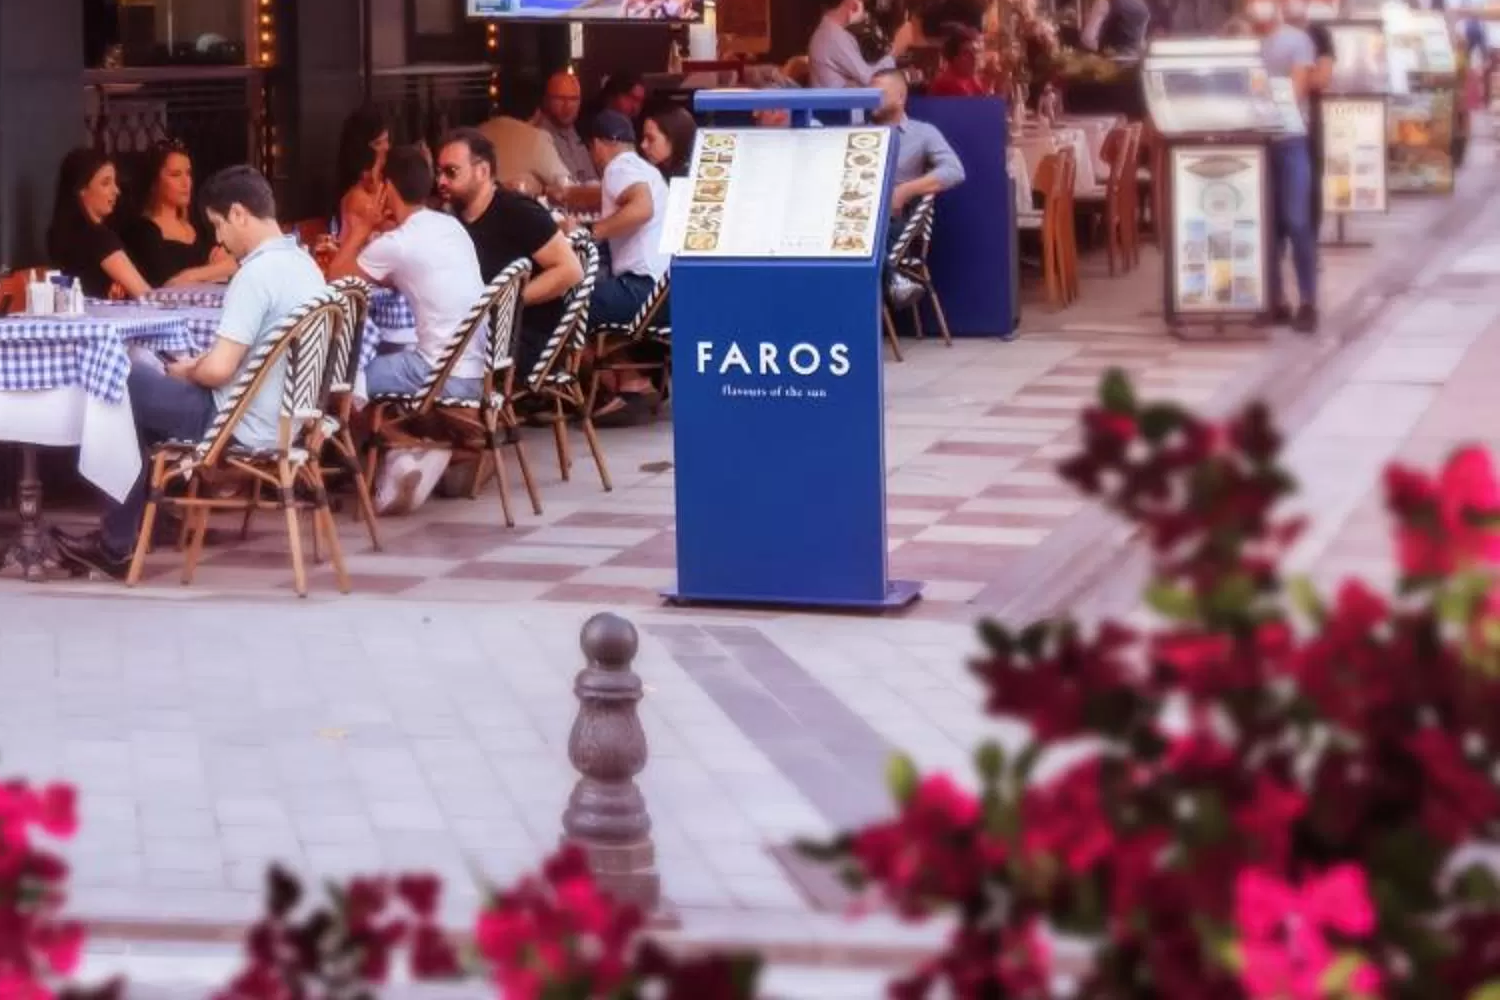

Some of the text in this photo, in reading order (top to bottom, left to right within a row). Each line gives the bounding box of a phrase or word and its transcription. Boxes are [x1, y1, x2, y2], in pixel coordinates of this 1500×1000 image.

[697, 341, 850, 376] FAROS
[770, 384, 783, 397] of
[785, 384, 803, 397] the
